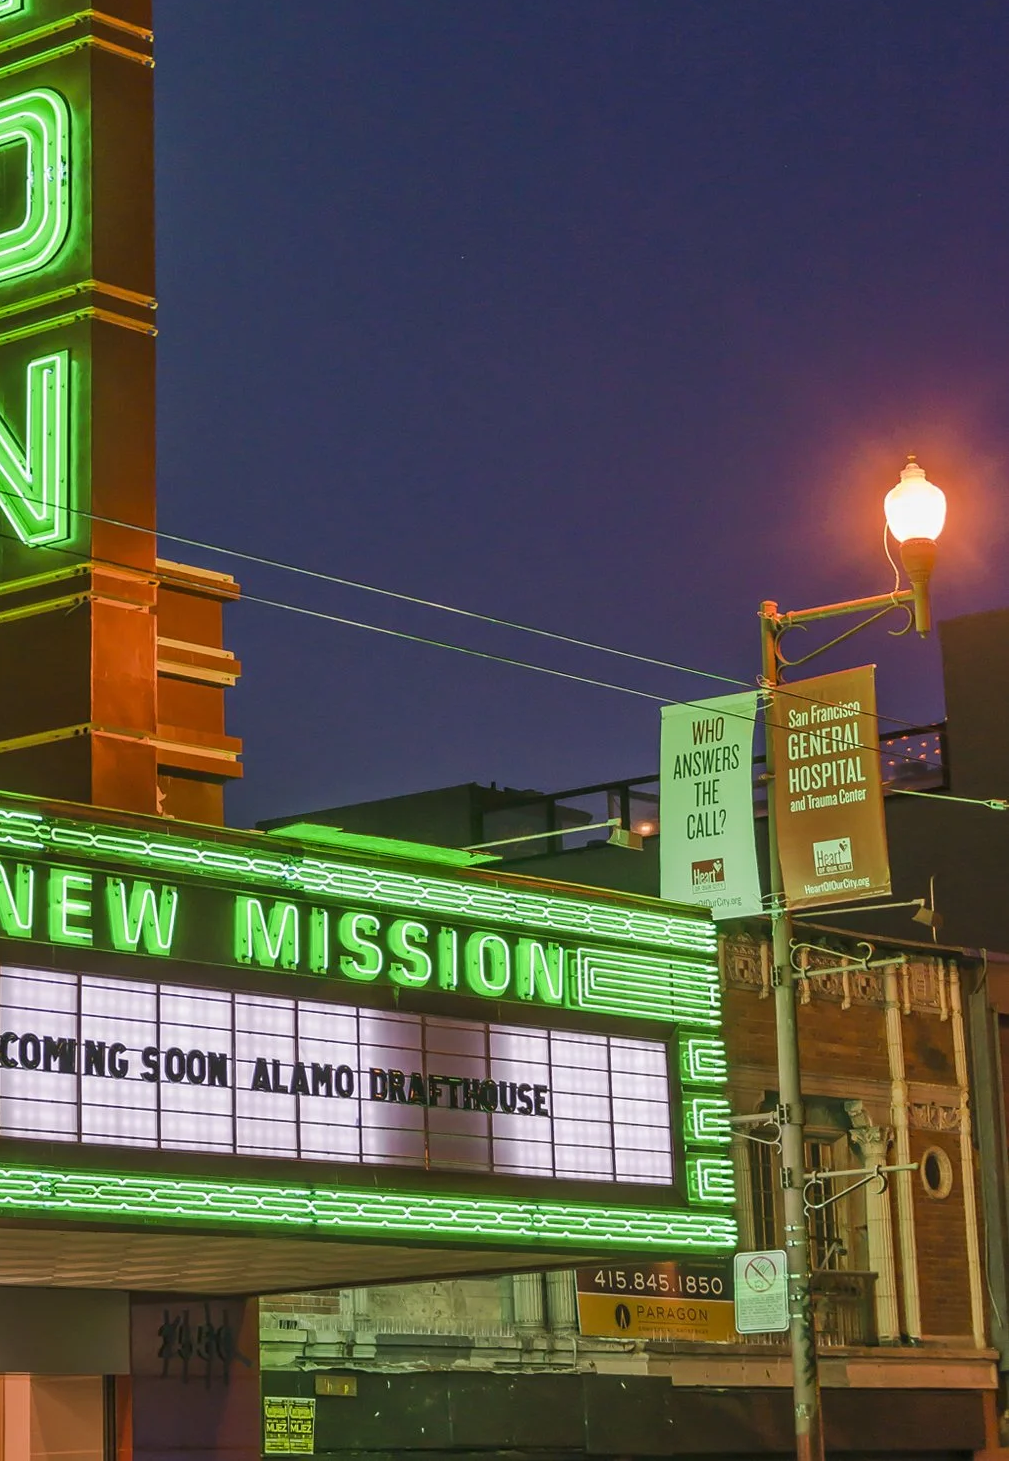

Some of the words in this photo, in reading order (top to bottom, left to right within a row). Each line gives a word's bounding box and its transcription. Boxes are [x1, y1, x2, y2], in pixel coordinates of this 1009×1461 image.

[788, 709, 809, 729] San
[811, 700, 861, 724] Francisco
[692, 716, 725, 746] WHO
[788, 721, 865, 761] GENERAL
[673, 743, 740, 780] ANSWERS
[788, 756, 867, 794] HOSPITAL
[694, 779, 721, 807] THE
[790, 796, 807, 813] and
[807, 793, 839, 810] Trauma
[838, 788, 867, 804] Center
[686, 809, 727, 840] CALL?
[816, 850, 842, 867] Heart
[818, 866, 826, 874] OF
[826, 865, 838, 873] OUR
[838, 863, 851, 871] CITY
[693, 868, 717, 886] Heart
[804, 876, 871, 895] HeartOfOurCity.org
[233, 895, 564, 1006] MISSION
[139, 1045, 229, 1088] SOON
[251, 1056, 356, 1099] ALAMO
[368, 1066, 550, 1117] DRAFTHOUSE
[594, 1269, 723, 1296] 415.845.1850
[636, 1304, 709, 1322] PARAGON
